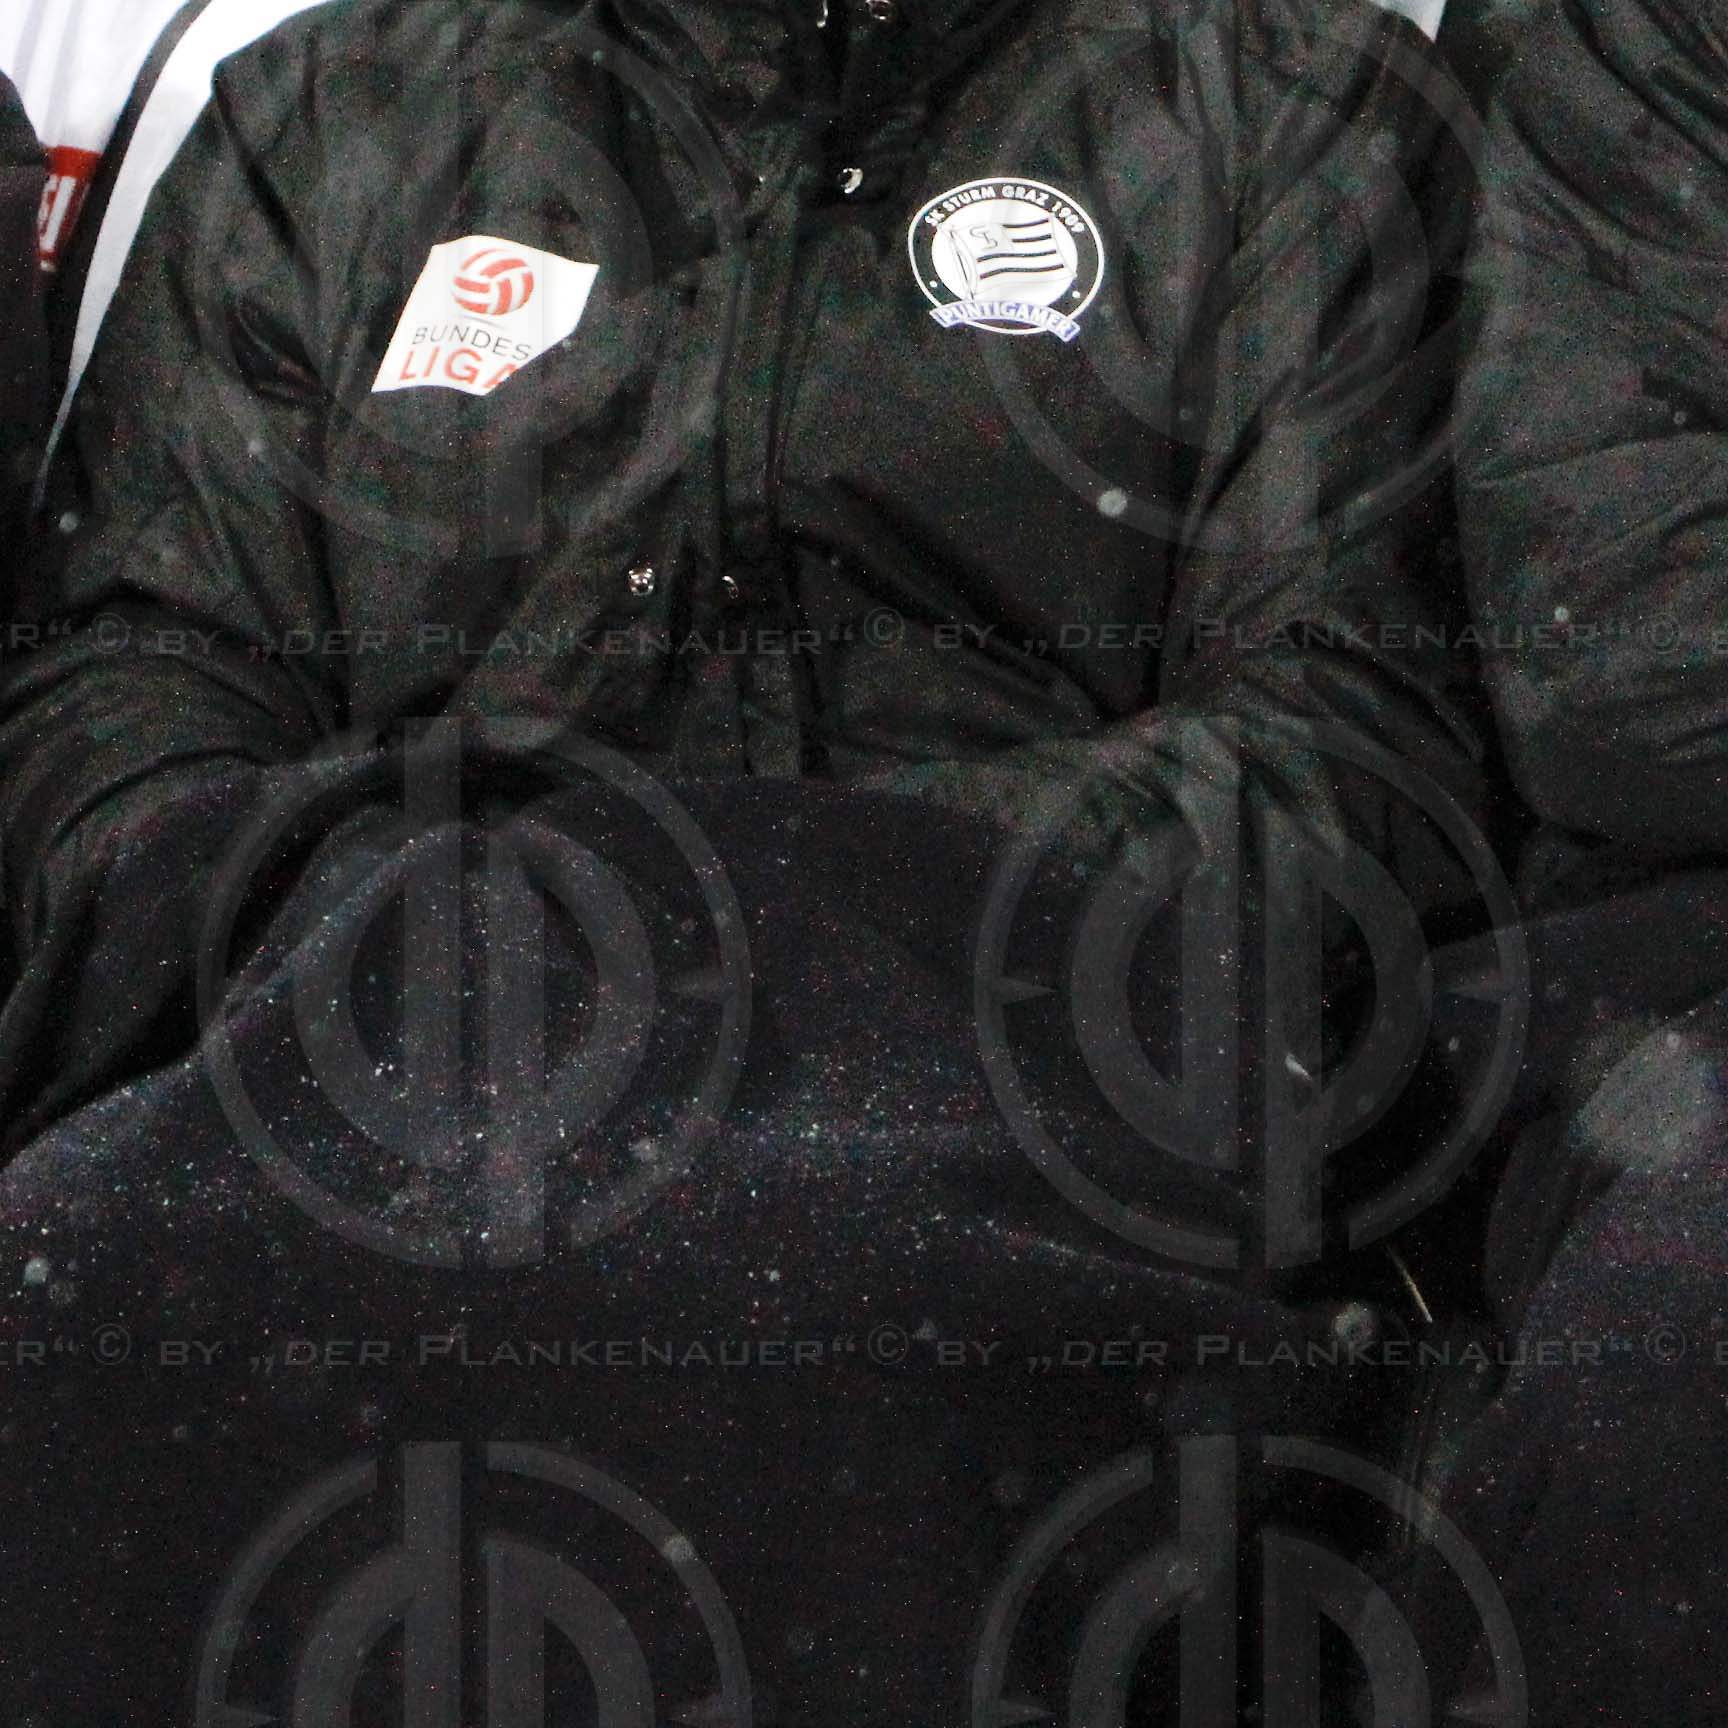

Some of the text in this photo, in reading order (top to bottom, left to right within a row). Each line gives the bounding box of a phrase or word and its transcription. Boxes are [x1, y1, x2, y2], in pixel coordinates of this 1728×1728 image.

[942, 184, 997, 213] STURM
[1000, 184, 1051, 207] GRAZ
[936, 301, 1073, 336] PUNTIGAMER
